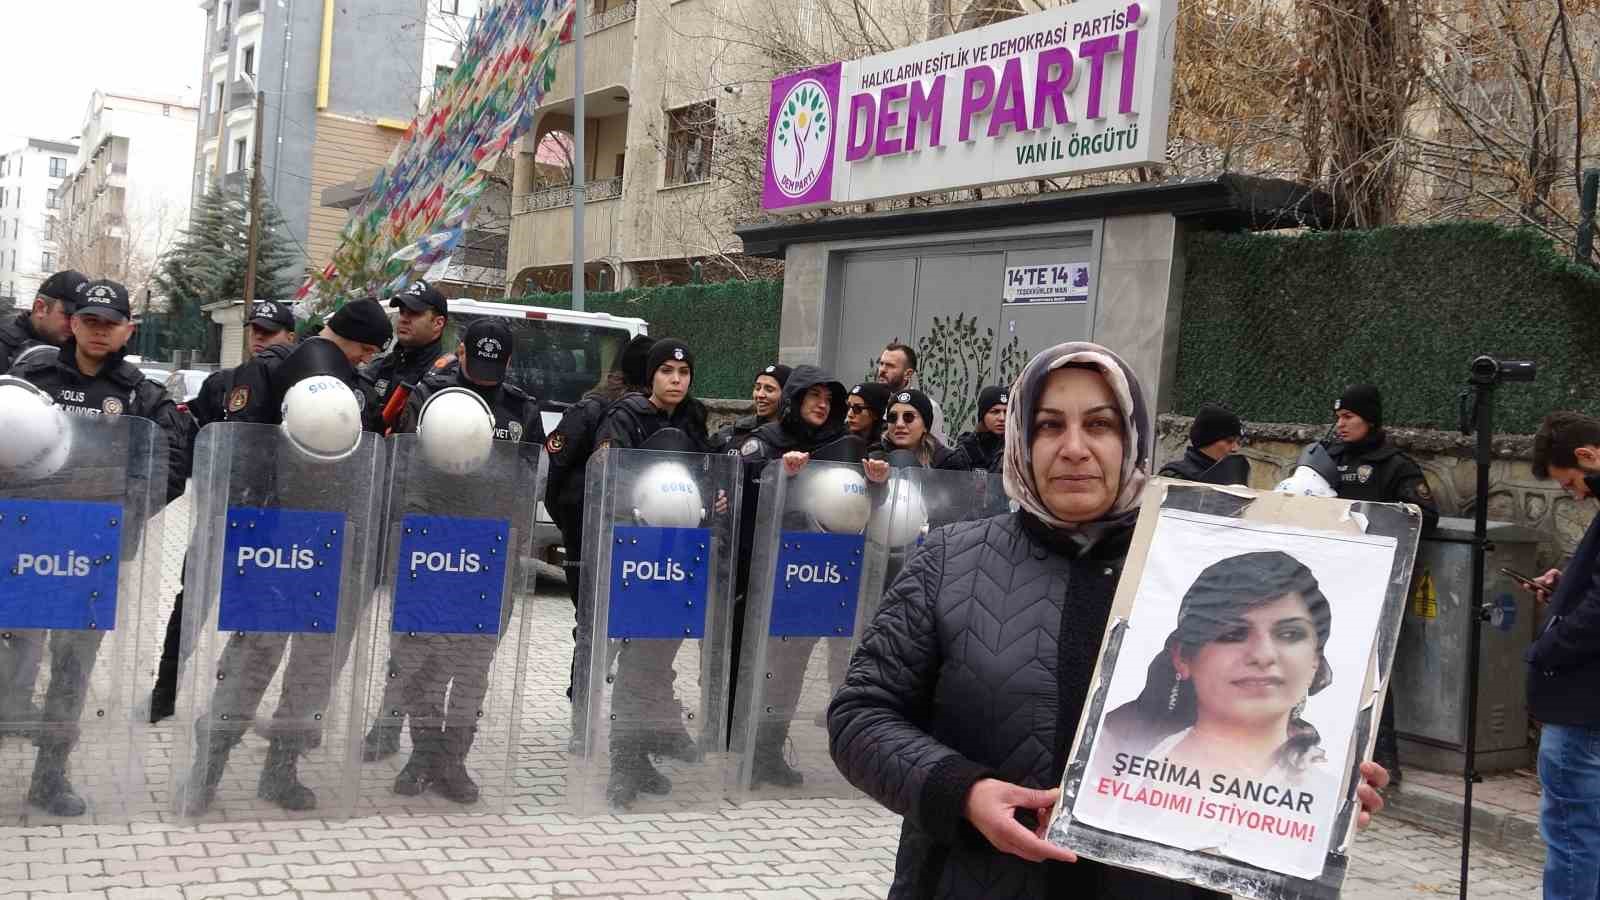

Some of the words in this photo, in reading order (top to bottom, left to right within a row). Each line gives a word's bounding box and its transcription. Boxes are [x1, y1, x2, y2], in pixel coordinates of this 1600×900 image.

[861, 61, 923, 89] HALKLARIN
[925, 47, 969, 76] EŞİTLİK
[973, 45, 989, 63] VE
[990, 21, 1068, 60] DEMOKRASİ
[846, 74, 947, 162] DEM
[958, 2, 1142, 142] PARTİ
[1016, 142, 1047, 166] VAN
[1050, 136, 1065, 161] İL
[1067, 124, 1138, 157] ÖRGÜTÜ
[781, 174, 795, 192] DEM
[794, 168, 815, 192] PARTİ
[1008, 267, 1048, 287] 14'TE
[1051, 266, 1069, 285] 14
[17, 551, 90, 577] POLİS
[237, 546, 315, 570] POLİS
[411, 549, 481, 573] POLİS
[622, 558, 686, 581] POLİS
[785, 561, 841, 583] POLİS
[1112, 752, 1201, 790] ŞERİMA
[1209, 773, 1315, 814] SANCAR
[1096, 777, 1193, 815] EVLADIMI
[1196, 796, 1316, 843] İSTİYORUM!
